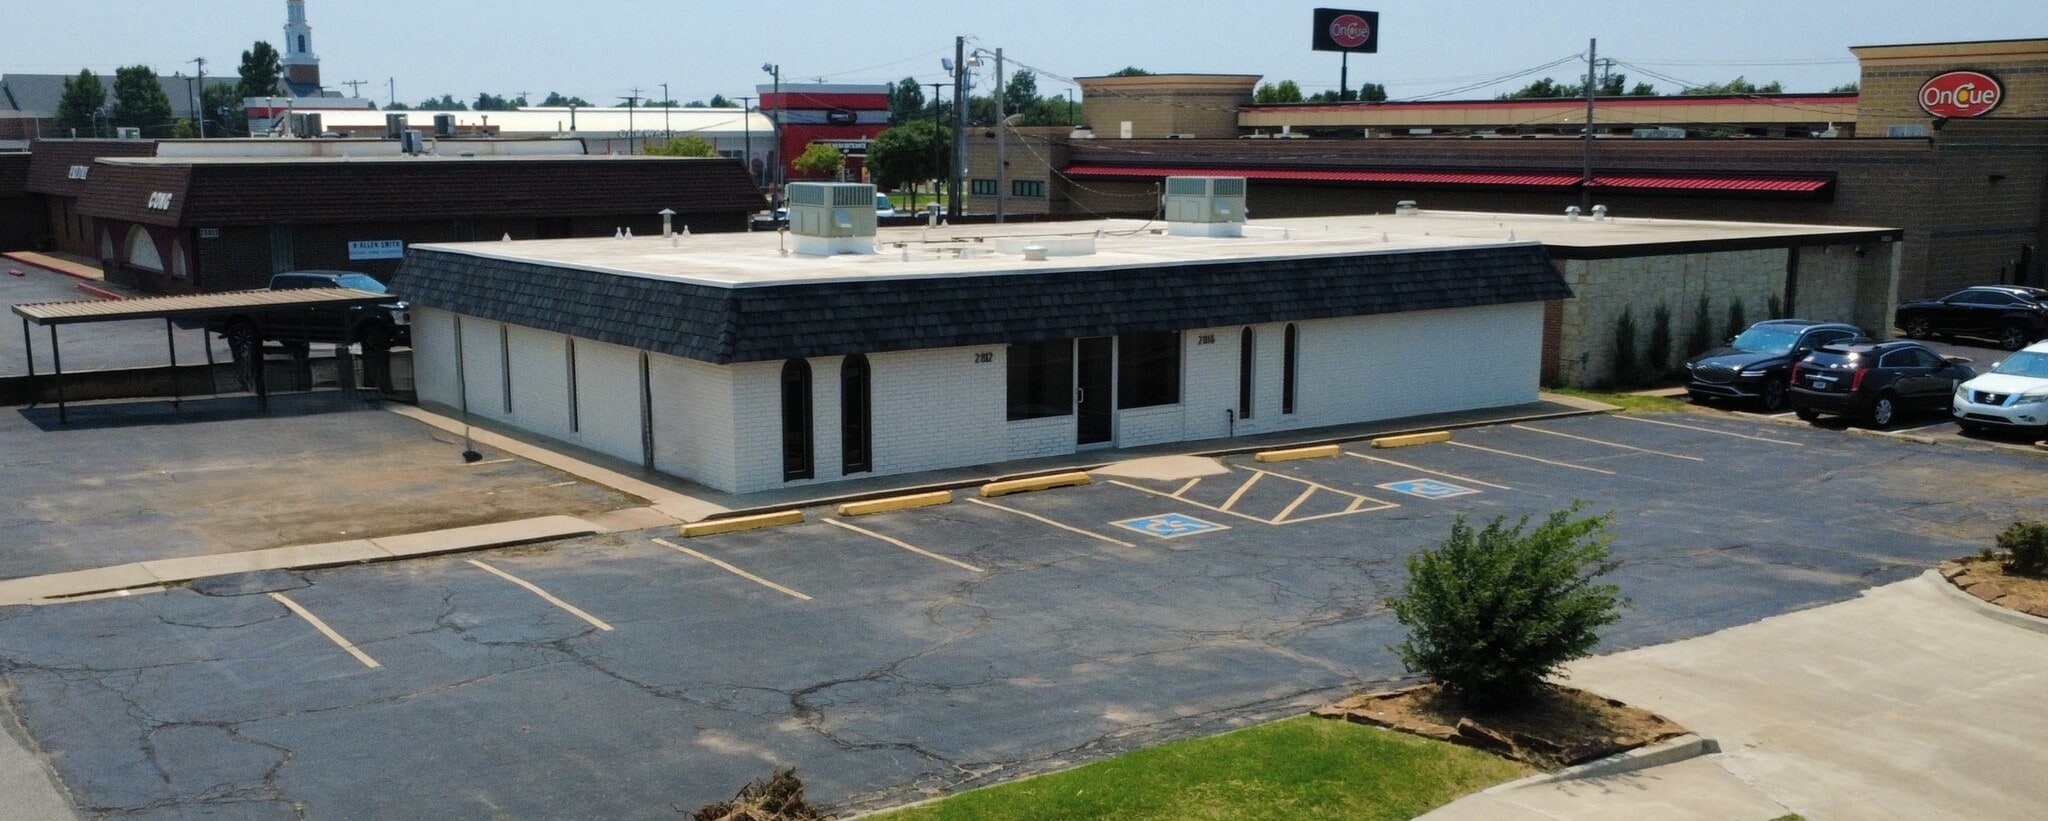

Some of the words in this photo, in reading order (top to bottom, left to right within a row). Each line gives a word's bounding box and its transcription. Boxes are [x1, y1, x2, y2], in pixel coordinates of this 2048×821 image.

[1332, 23, 1367, 39] OnCue
[1924, 82, 1994, 108] OnCue
[974, 351, 994, 364] 2812
